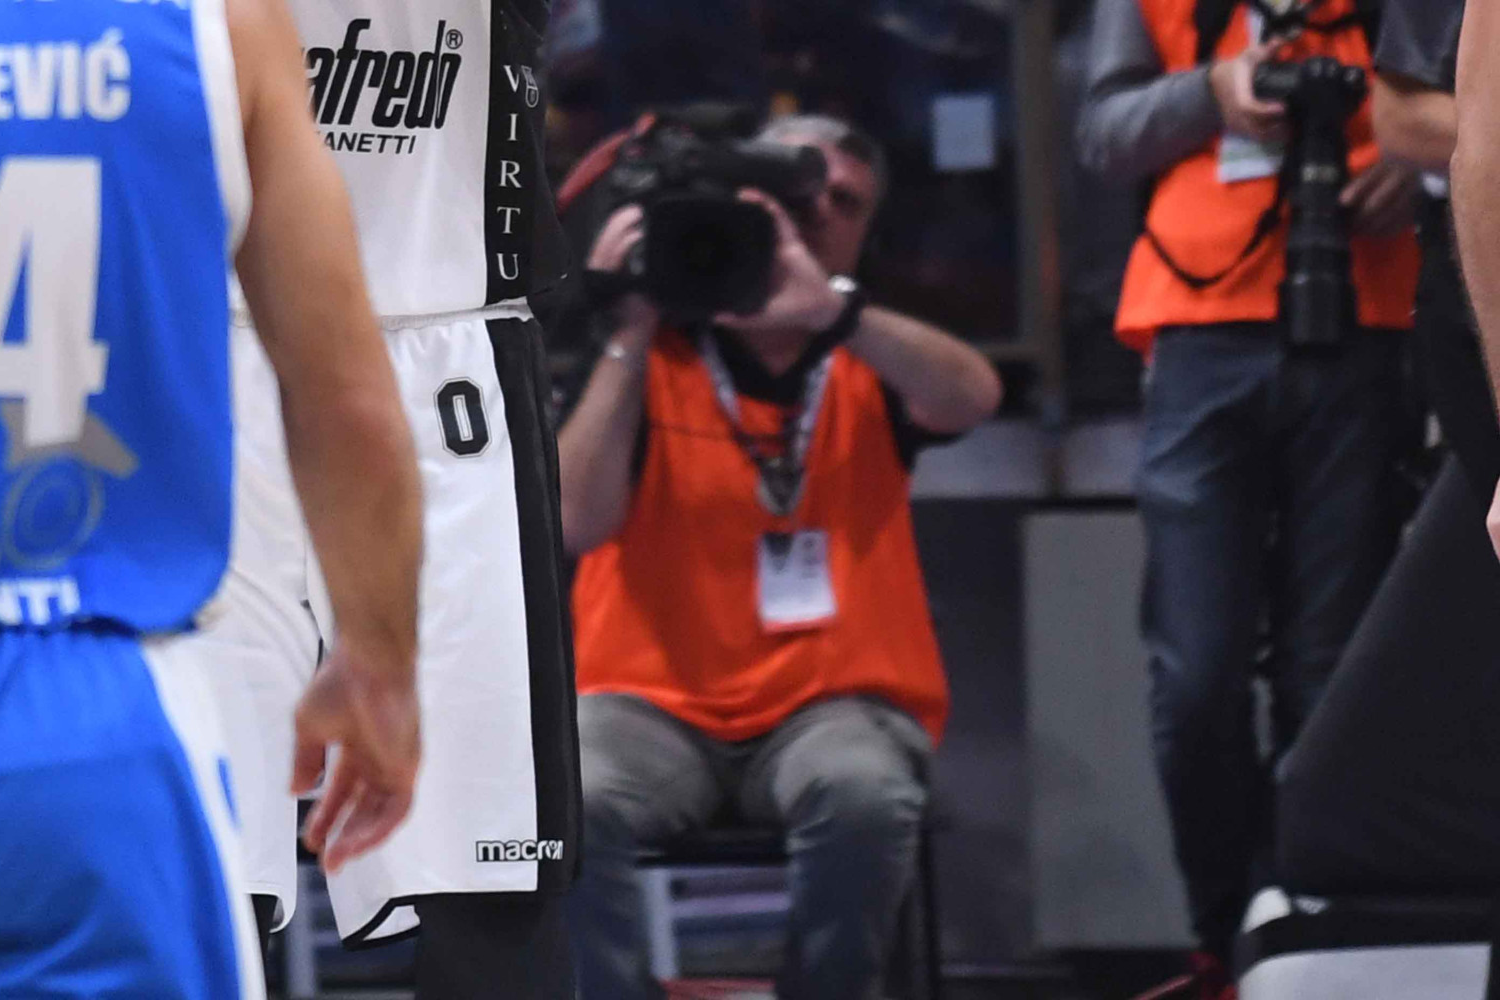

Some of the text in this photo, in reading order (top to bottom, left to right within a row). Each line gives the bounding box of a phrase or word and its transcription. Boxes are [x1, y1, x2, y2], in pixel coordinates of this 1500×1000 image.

[306, 18, 462, 130] afredo
[322, 131, 417, 155] ANETTI
[433, 376, 493, 458] 0
